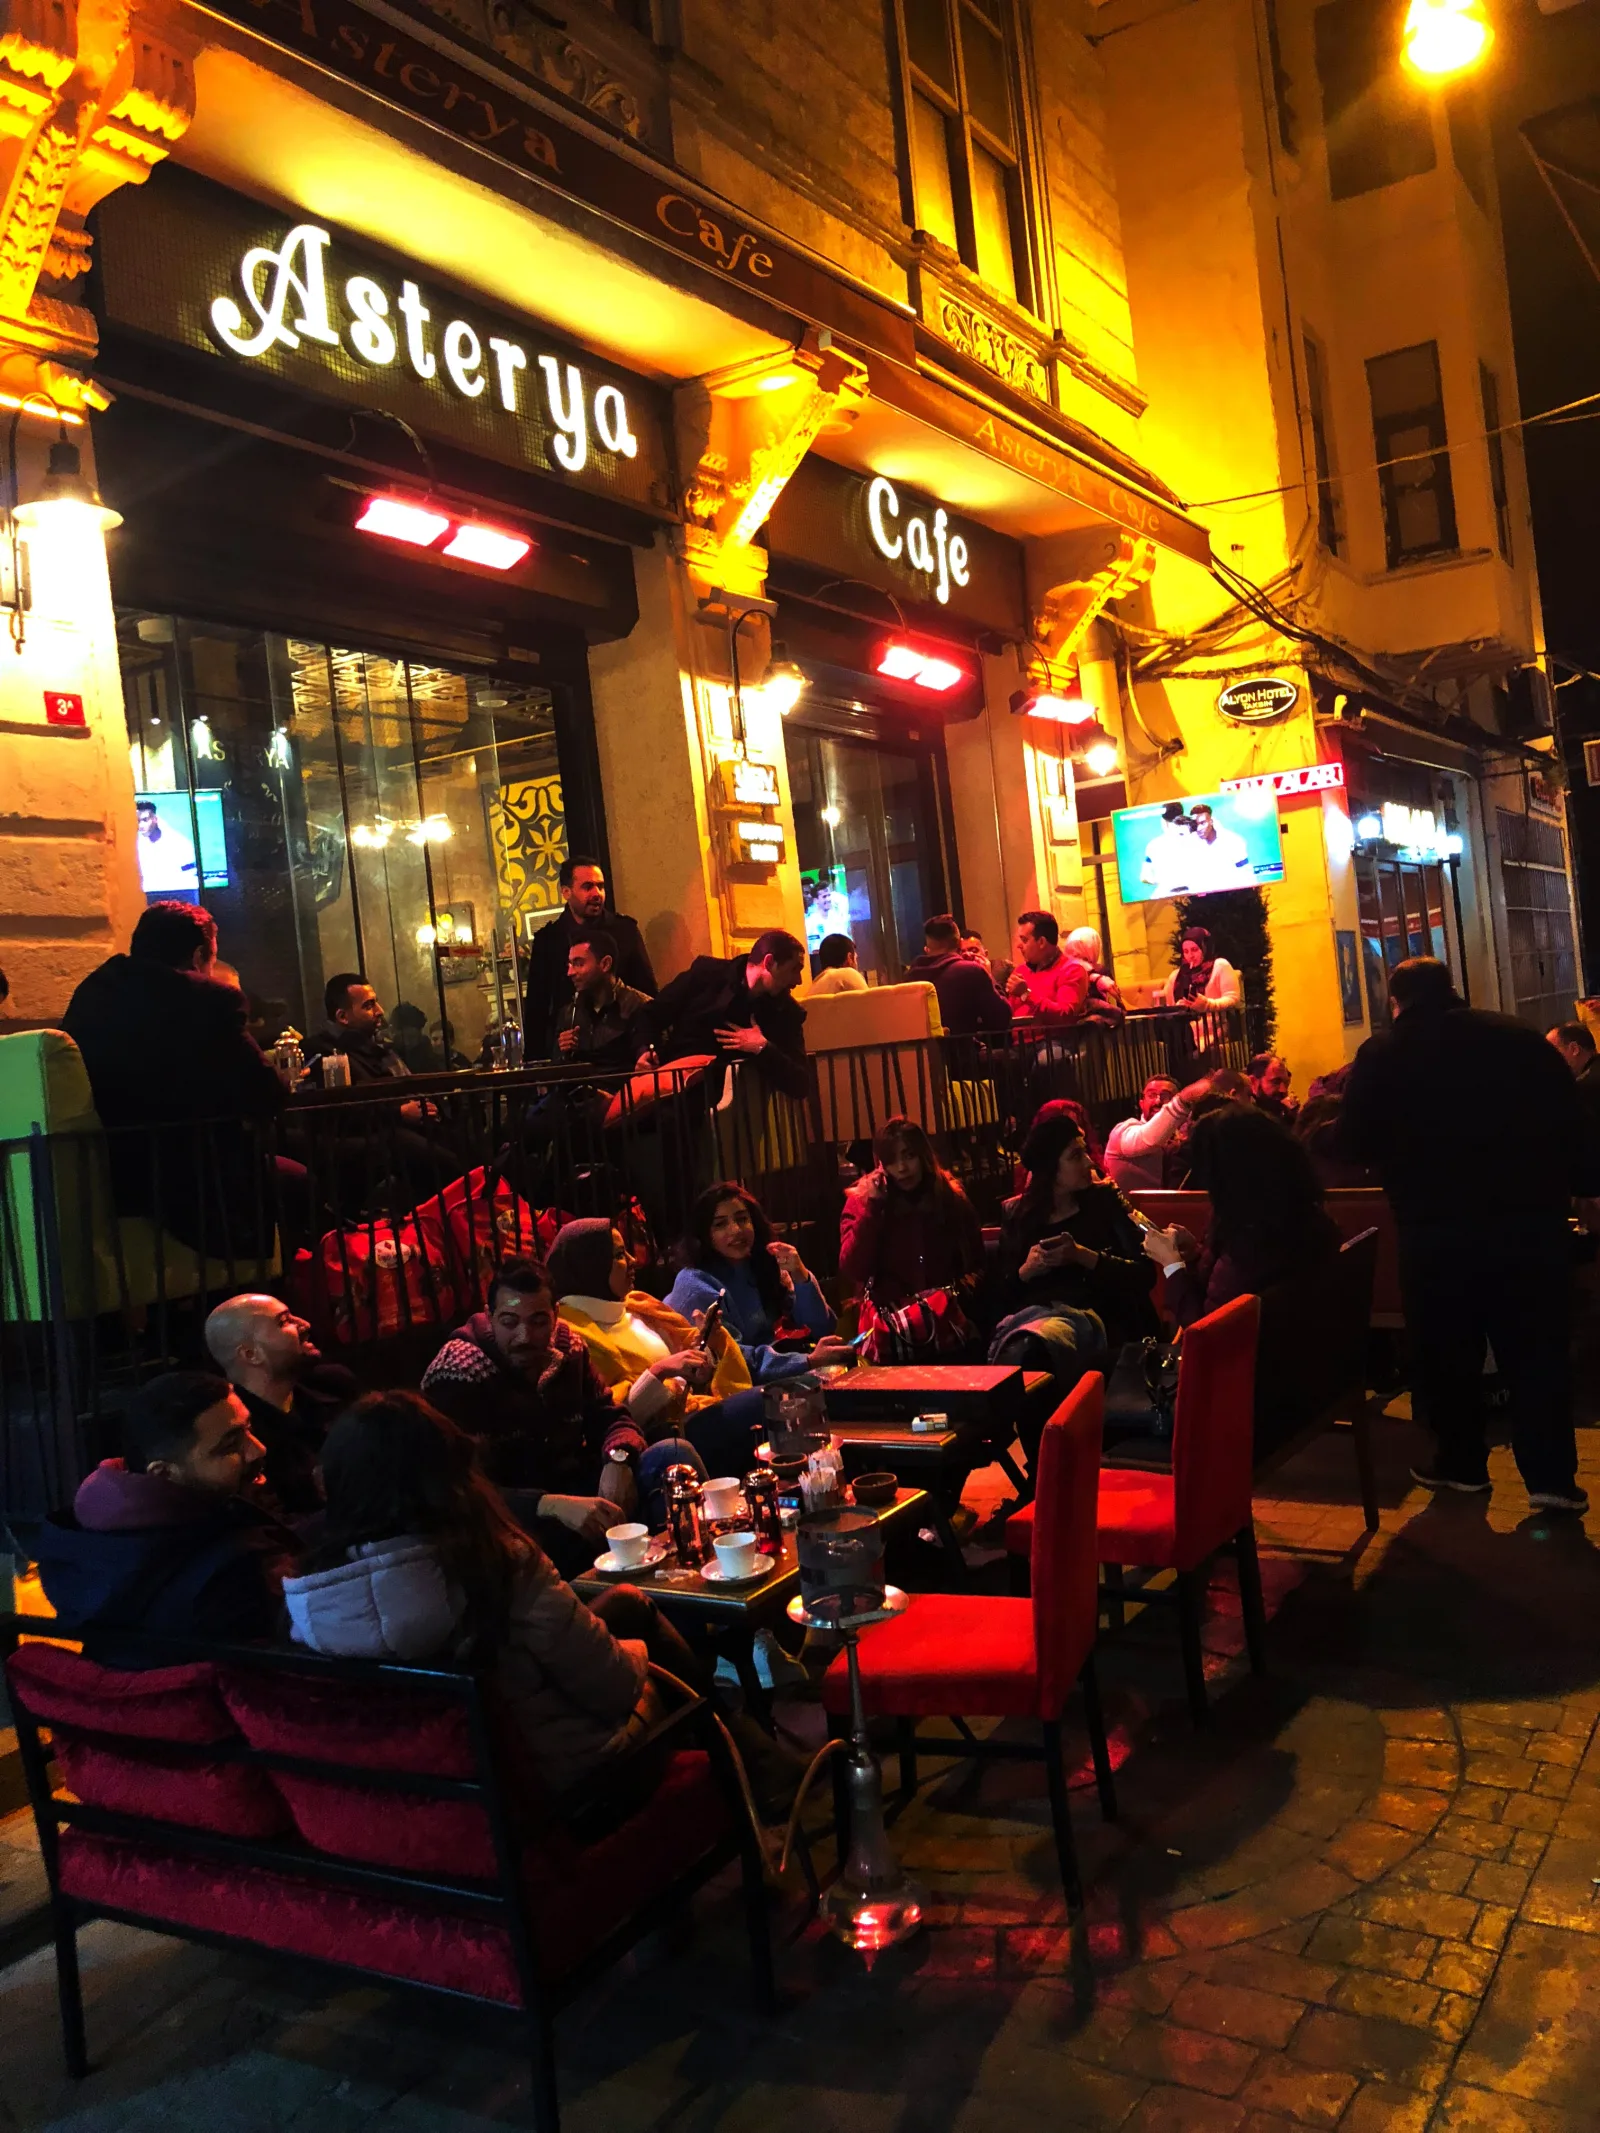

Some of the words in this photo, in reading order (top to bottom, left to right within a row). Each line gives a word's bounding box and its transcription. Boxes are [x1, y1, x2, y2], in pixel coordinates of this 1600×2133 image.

[656, 194, 774, 278] Cafe
[210, 224, 638, 473] Asterya
[973, 417, 1085, 496] Asterya
[1108, 488, 1161, 532] Cafe
[868, 476, 971, 605] Cafe
[1257, 686, 1294, 701] HOTEL
